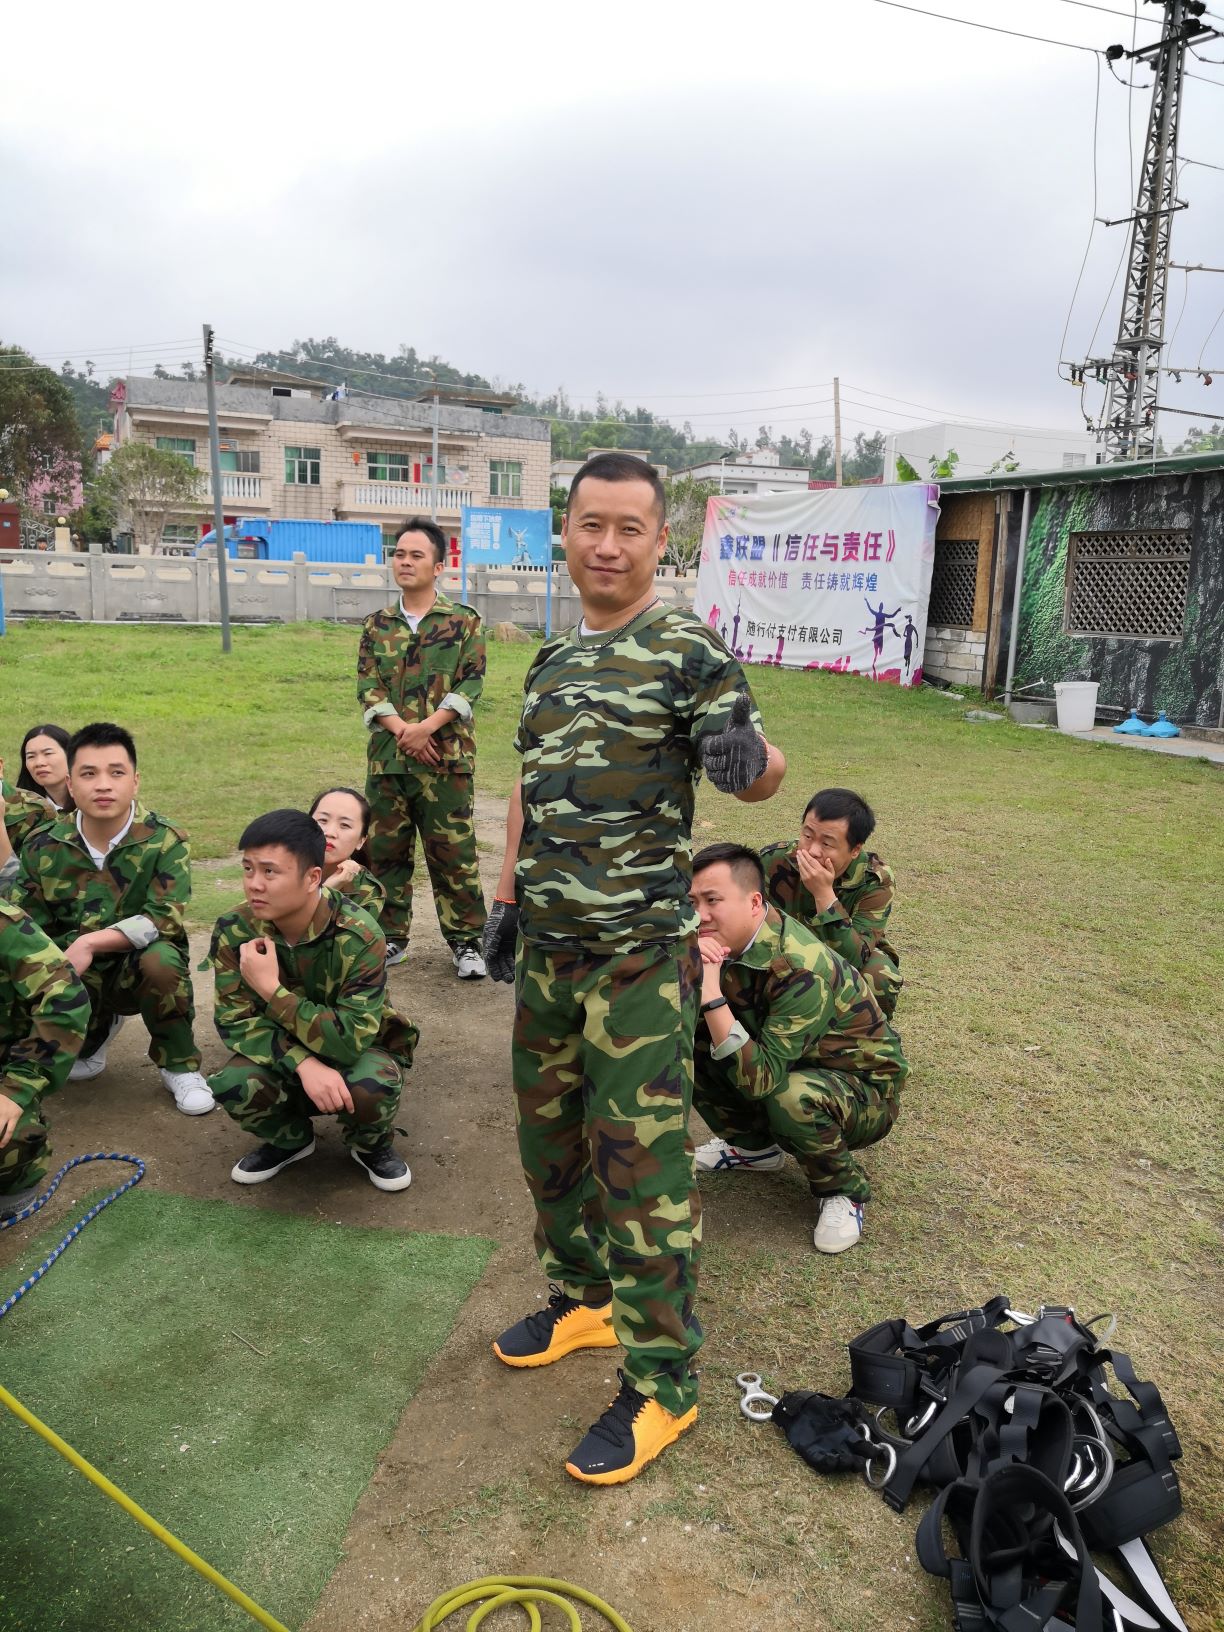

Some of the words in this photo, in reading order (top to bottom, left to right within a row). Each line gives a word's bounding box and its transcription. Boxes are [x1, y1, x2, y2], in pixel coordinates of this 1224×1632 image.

[728, 570, 788, 589] 信任成就价值
[801, 572, 878, 592] 责任铸就辉煌
[746, 621, 843, 645] 随行付支付有限公司
